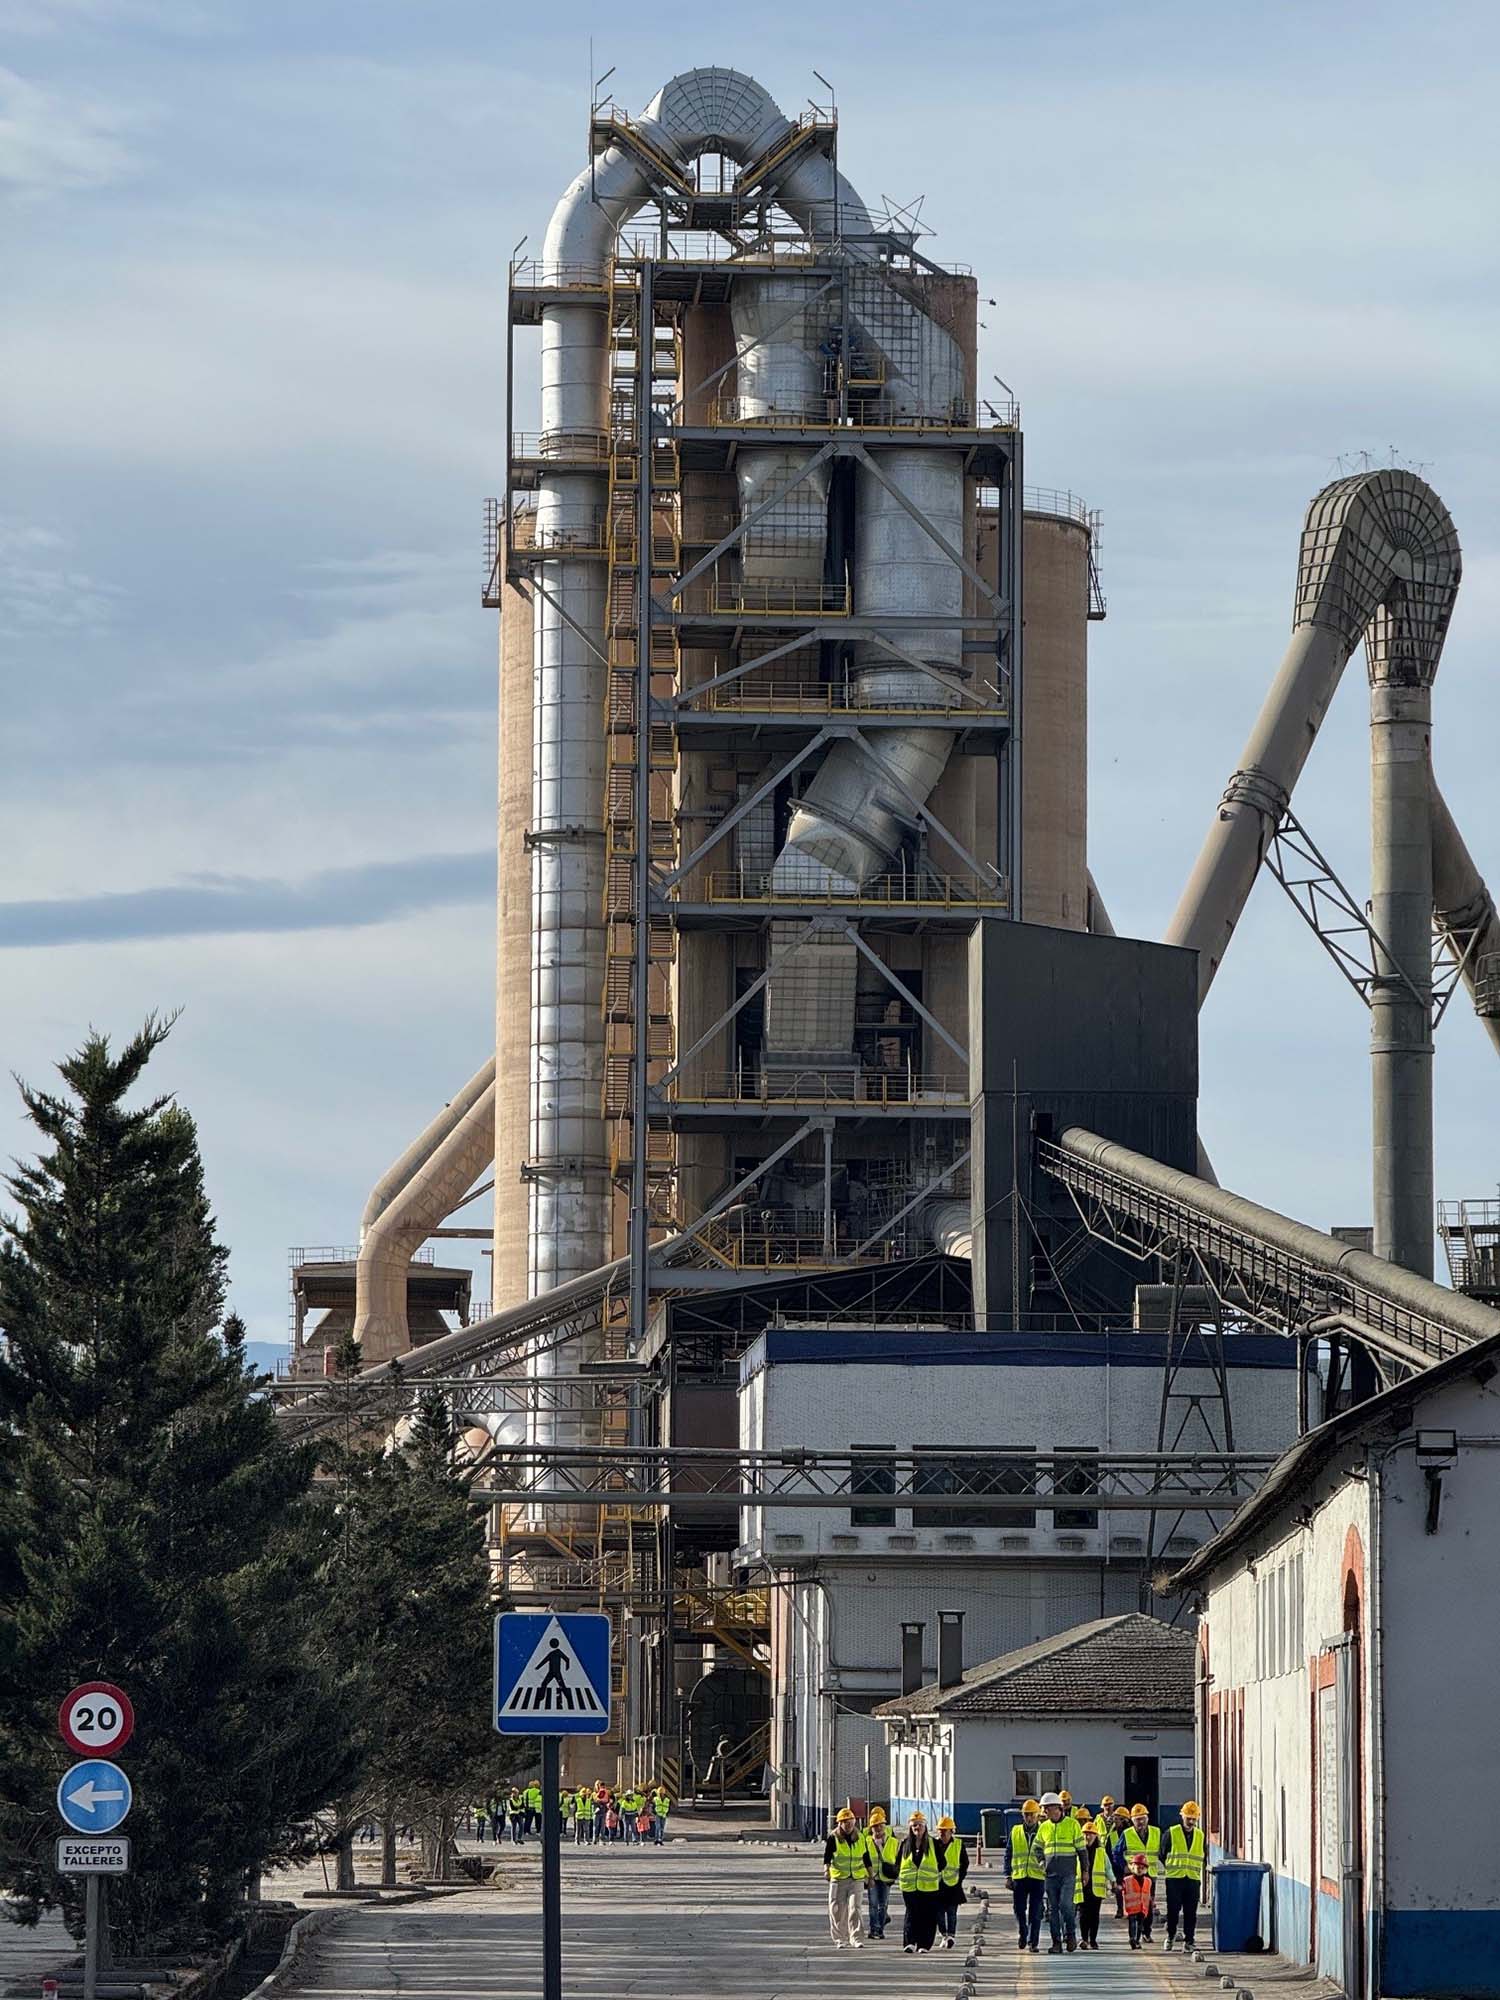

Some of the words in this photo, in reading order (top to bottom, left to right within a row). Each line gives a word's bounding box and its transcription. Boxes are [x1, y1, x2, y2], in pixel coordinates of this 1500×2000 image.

[76, 1707, 117, 1731] 20
[66, 1846, 121, 1855] EXCEPTO
[63, 1857, 124, 1865] TALLERES
